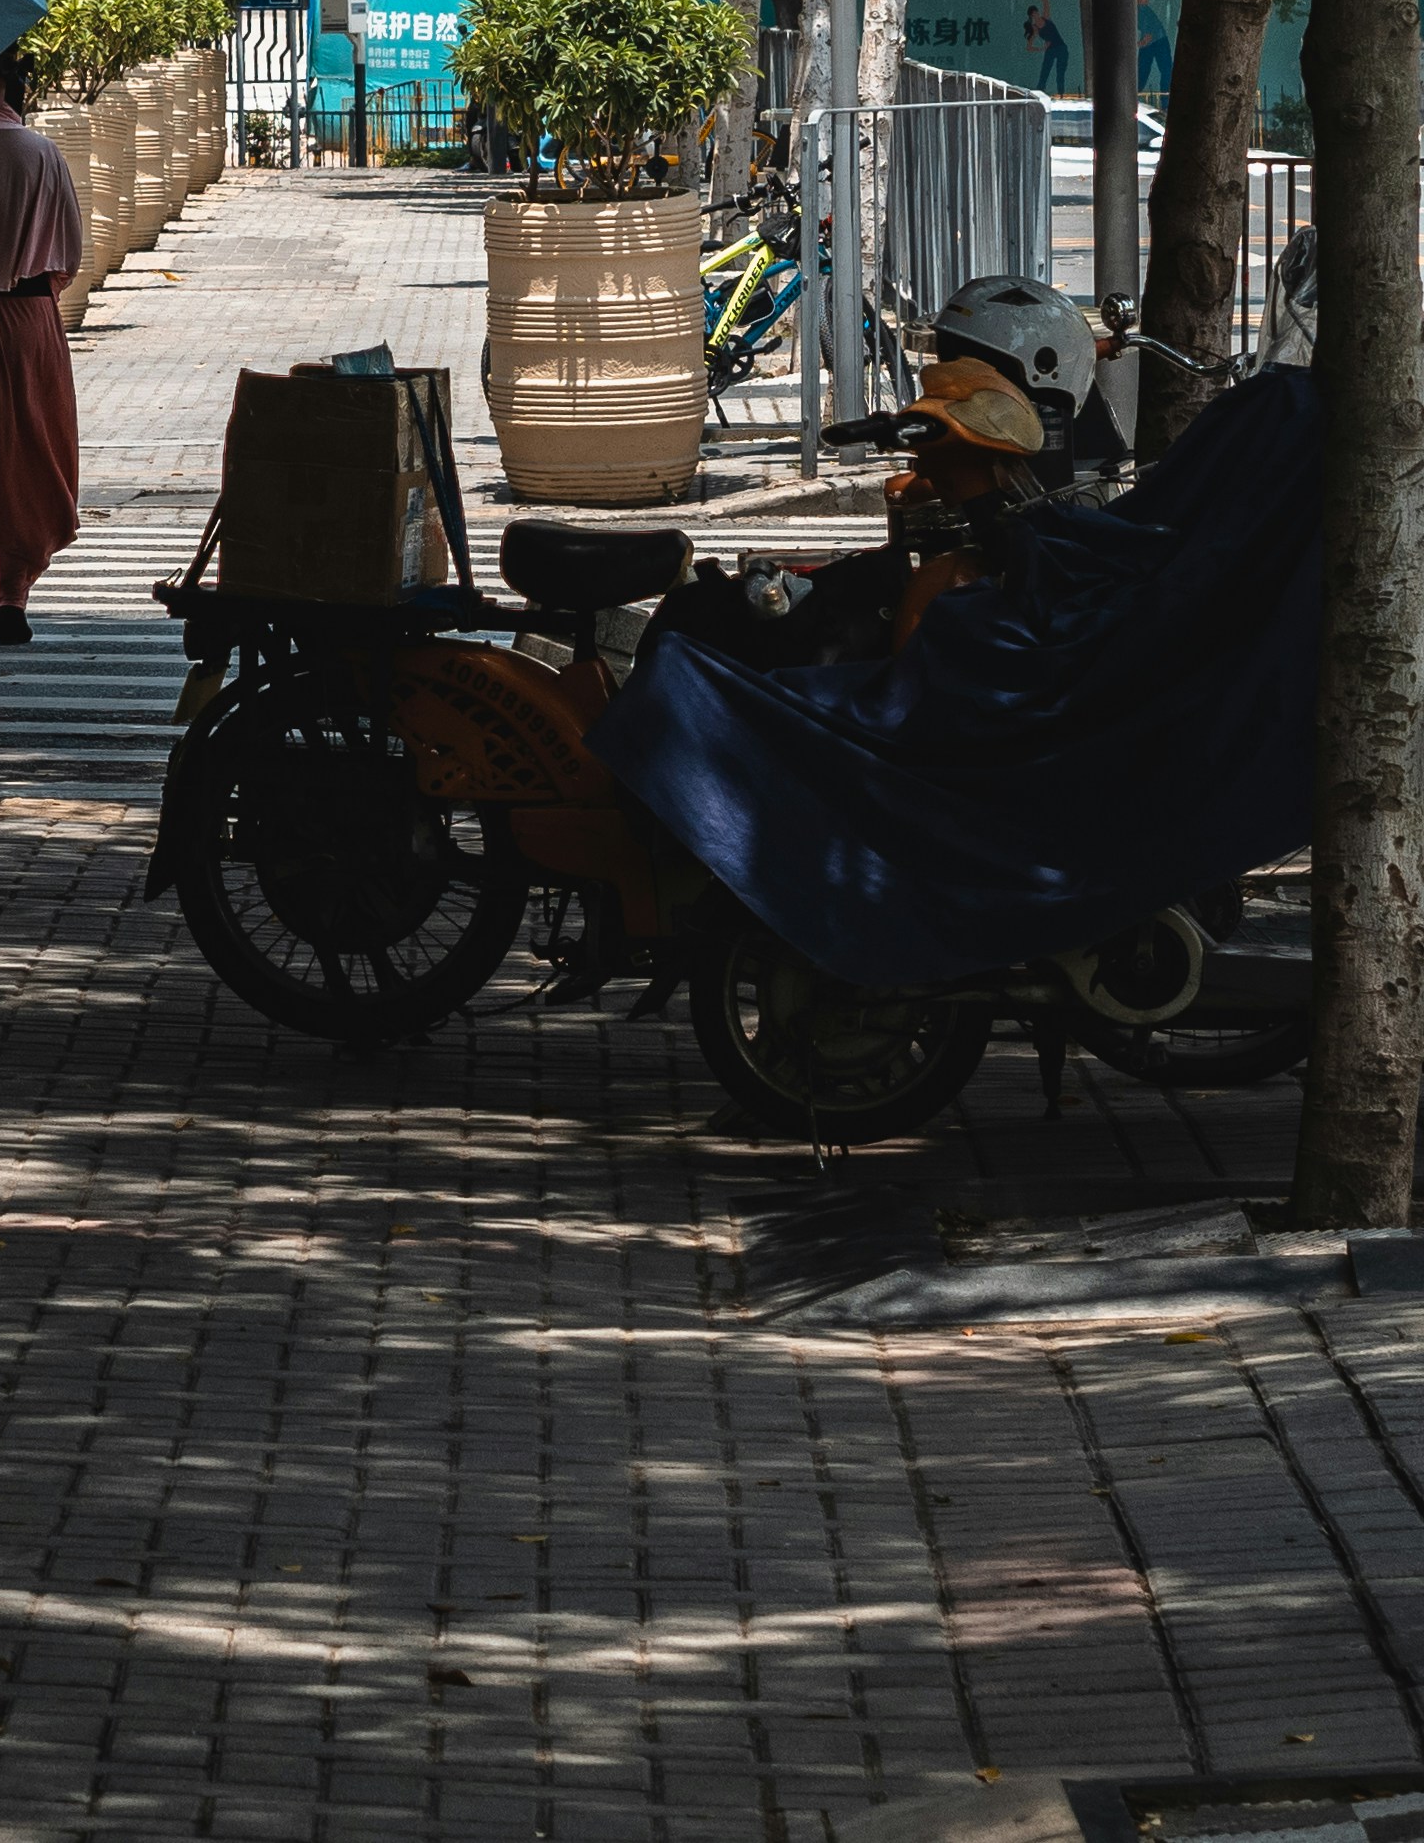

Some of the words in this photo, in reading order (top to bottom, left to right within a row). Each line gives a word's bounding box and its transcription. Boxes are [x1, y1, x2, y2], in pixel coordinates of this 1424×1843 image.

[366, 11, 458, 41] 保护自然
[714, 256, 767, 347] ROCKRIDER
